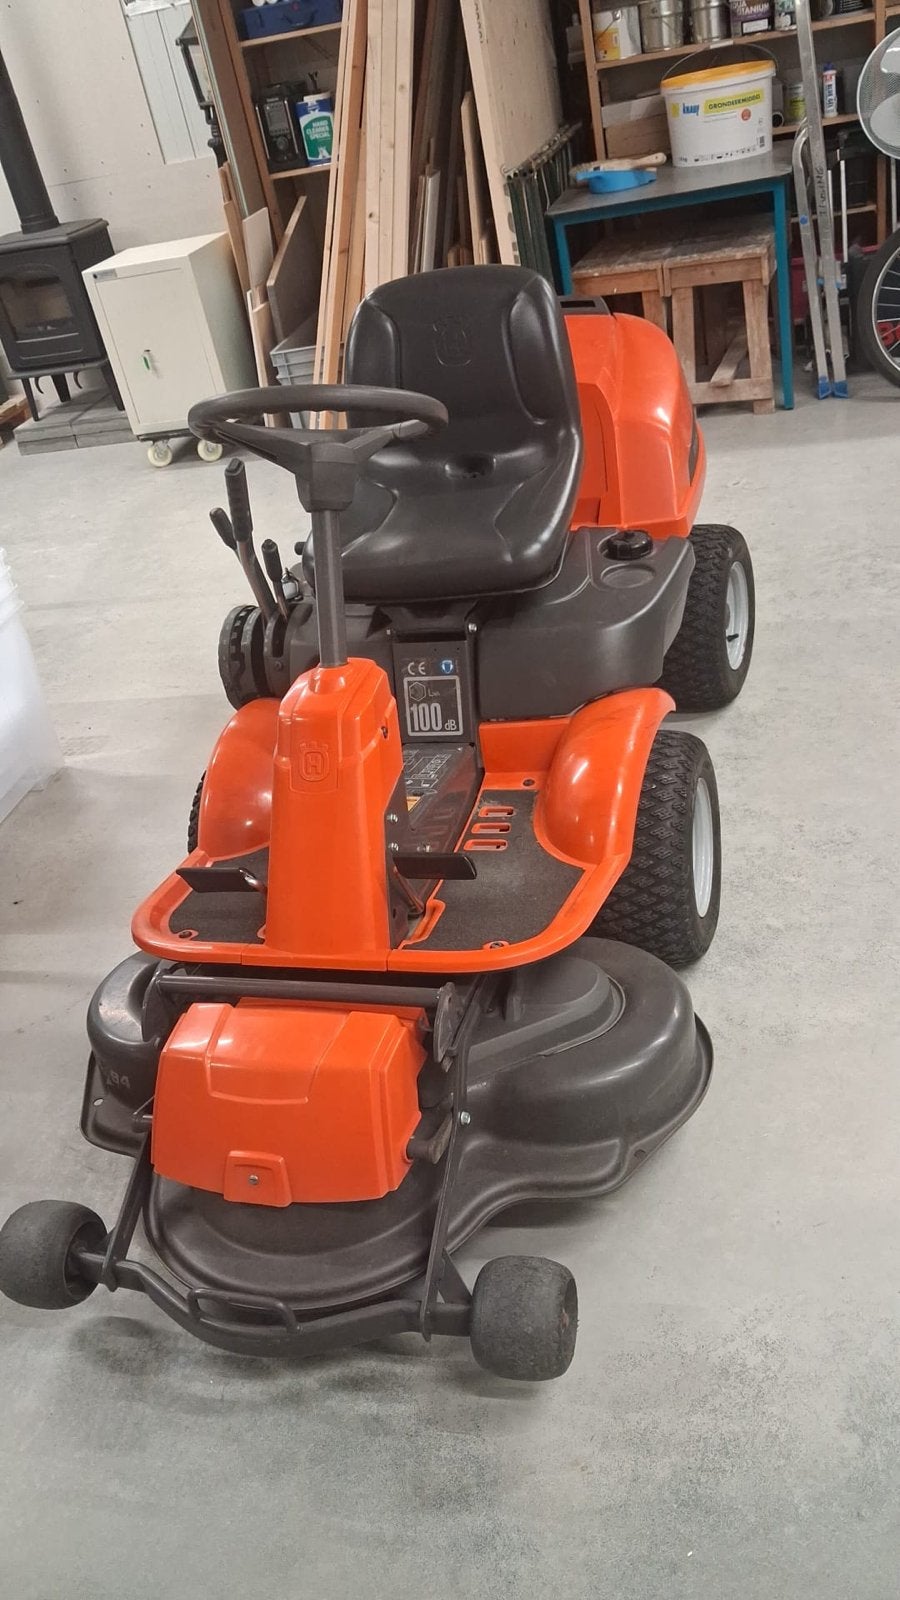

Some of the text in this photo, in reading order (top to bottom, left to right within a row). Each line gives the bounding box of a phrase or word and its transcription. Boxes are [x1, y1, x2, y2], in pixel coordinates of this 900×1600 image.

[306, 125, 330, 135] CLEANER
[310, 132, 330, 140] SPECIAL
[407, 661, 427, 675] CE
[410, 703, 458, 732] 100 dB
